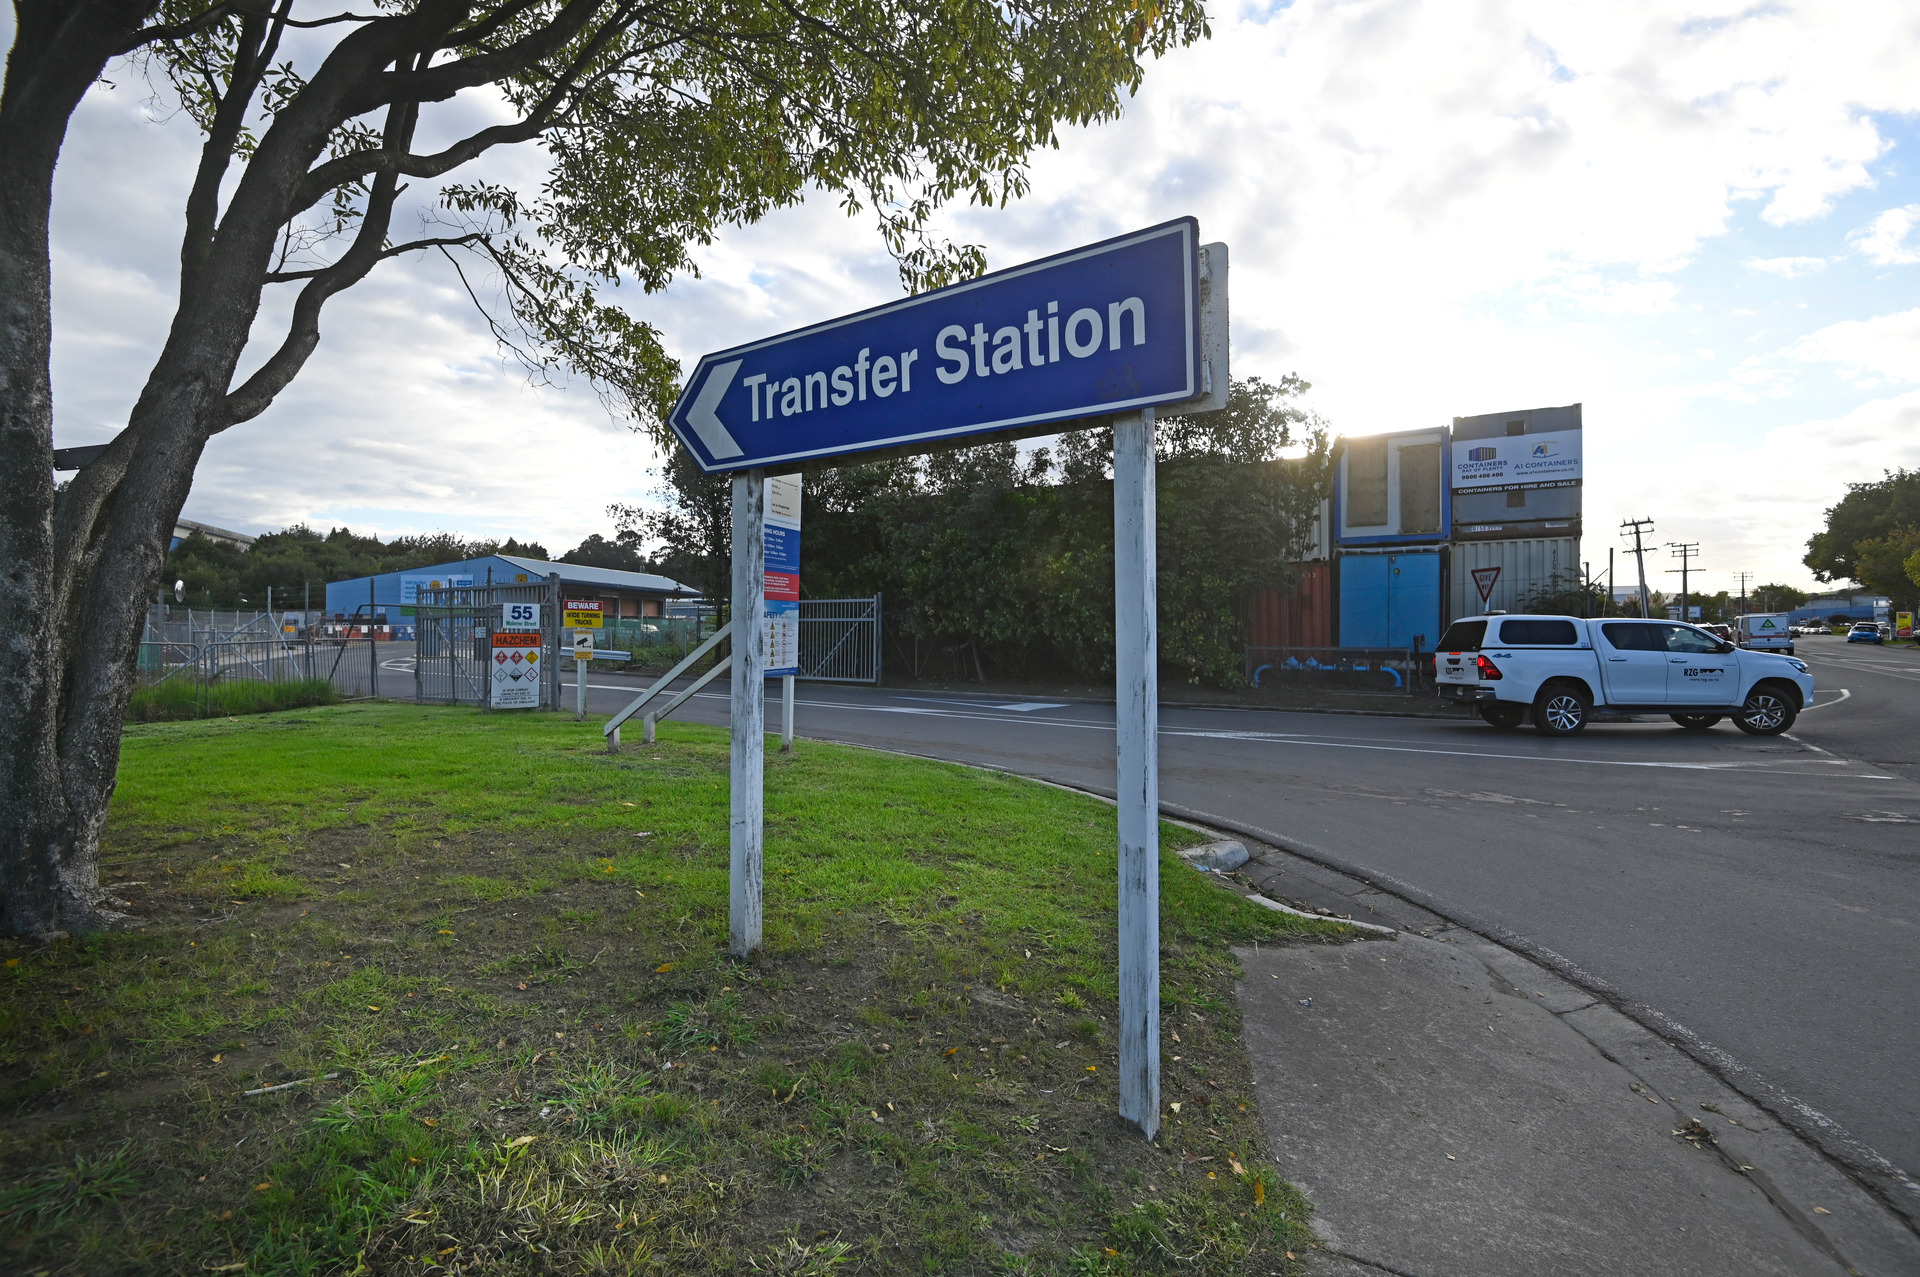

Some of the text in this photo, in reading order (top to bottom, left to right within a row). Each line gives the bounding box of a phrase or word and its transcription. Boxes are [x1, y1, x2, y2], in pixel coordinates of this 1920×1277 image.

[743, 296, 1145, 422] Transfer Station
[1458, 460, 1508, 469] CONTAINERS
[1525, 459, 1578, 468] CONTAINERS
[1480, 574, 1492, 582] GIVE
[511, 606, 532, 620] 55
[496, 636, 537, 645] HAZCHEM
